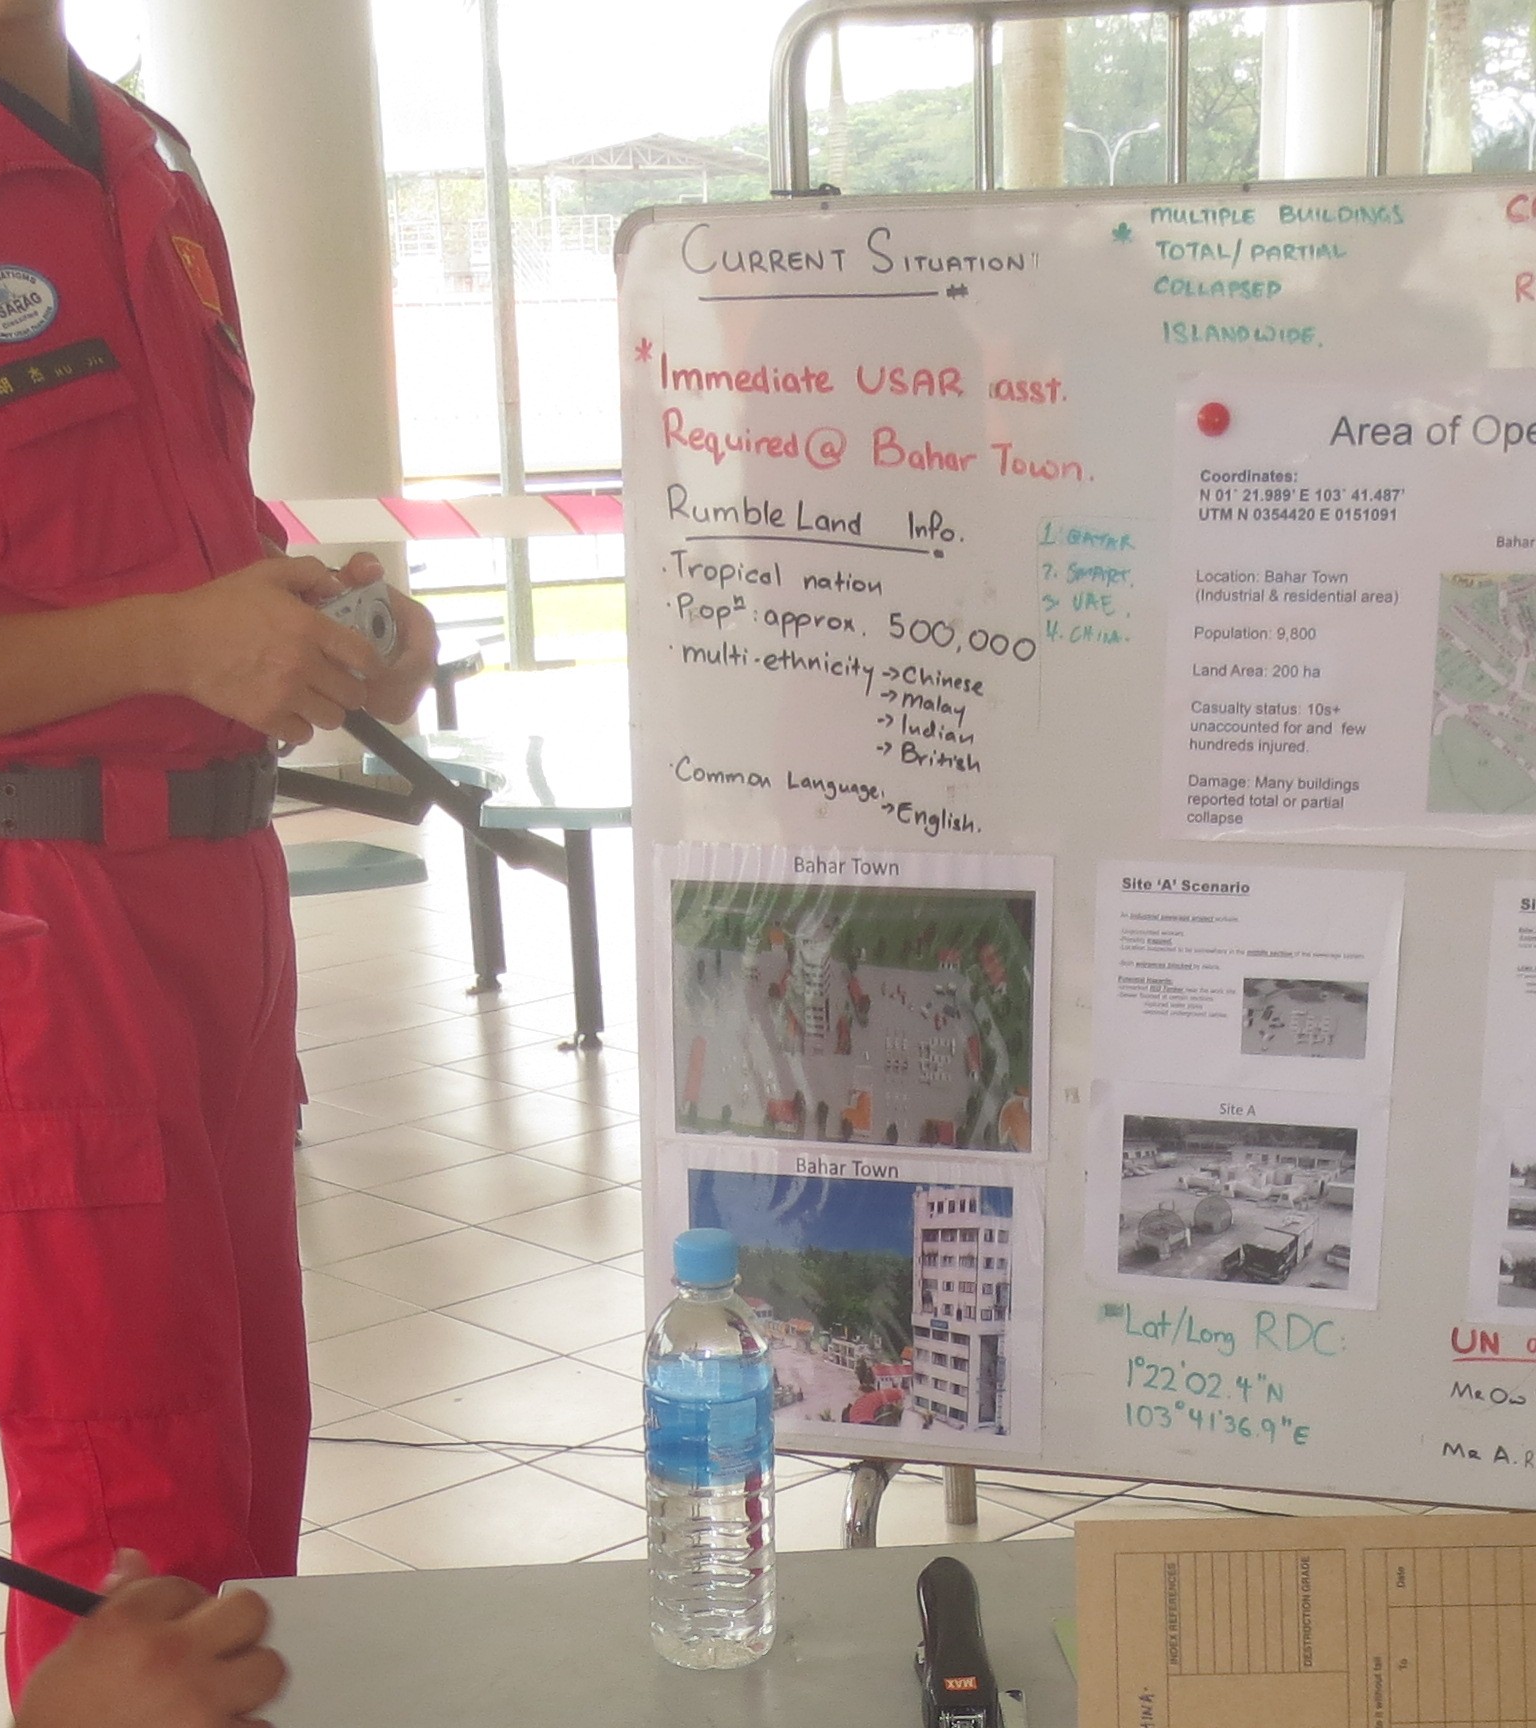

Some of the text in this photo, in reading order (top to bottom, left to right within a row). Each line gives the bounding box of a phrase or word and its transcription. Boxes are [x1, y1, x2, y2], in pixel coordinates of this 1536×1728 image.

[1150, 204, 1404, 226] MULTIPLE BUILDINGS
[682, 223, 846, 275] CURRENT
[1154, 276, 1281, 299] COLLAPSED
[661, 352, 834, 394] Immediate
[856, 367, 964, 396] USAR
[1330, 416, 1414, 446] Area
[1426, 415, 1461, 445] of
[873, 427, 977, 472] Bahar
[1200, 470, 1298, 483] Coordinates:
[1200, 489, 1210, 500] N
[1300, 489, 1309, 500] E
[1199, 509, 1233, 520] UTM
[1238, 509, 1248, 520] N
[1253, 509, 1315, 521] 0354420
[1320, 509, 1330, 521] E
[1496, 536, 1536, 548] Bahar
[670, 550, 883, 596] Tropical nation
[1196, 570, 1348, 584] Location: Bahar Town
[1196, 590, 1399, 604] (Industrial & residential area)
[889, 612, 1036, 661] 500,000
[1194, 626, 1316, 642] Population: 9,800
[902, 666, 984, 697] Chinese
[1193, 665, 1320, 678] Land Area: 200 ha
[1191, 702, 1340, 717] Casualty status: 10s+
[902, 714, 974, 745] Indian
[1190, 721, 1366, 736] unaccounted for and few
[902, 741, 981, 773] British
[1189, 739, 1309, 754] hundreds injured.
[675, 756, 771, 787] Common
[1188, 775, 1359, 792] Damage: Many buildings
[1187, 793, 1344, 811] reported total or partial
[1187, 811, 1243, 825] collapse
[794, 856, 899, 877] Bahar Town
[1122, 878, 1152, 891] Site
[1181, 880, 1250, 894] Scenario
[1220, 1103, 1256, 1116] Site A
[796, 1158, 898, 1179] Bahar Town
[1126, 1303, 1235, 1356] Lat/Long
[1452, 1328, 1500, 1354] UN
[1396, 1565, 1406, 1588] Date
[1168, 1563, 1178, 1665] INDEX REFERENCES
[1302, 1556, 1313, 1668] DESTRUCTION GRADE
[1399, 1657, 1409, 1670] To
[946, 1677, 976, 1689] MAX
